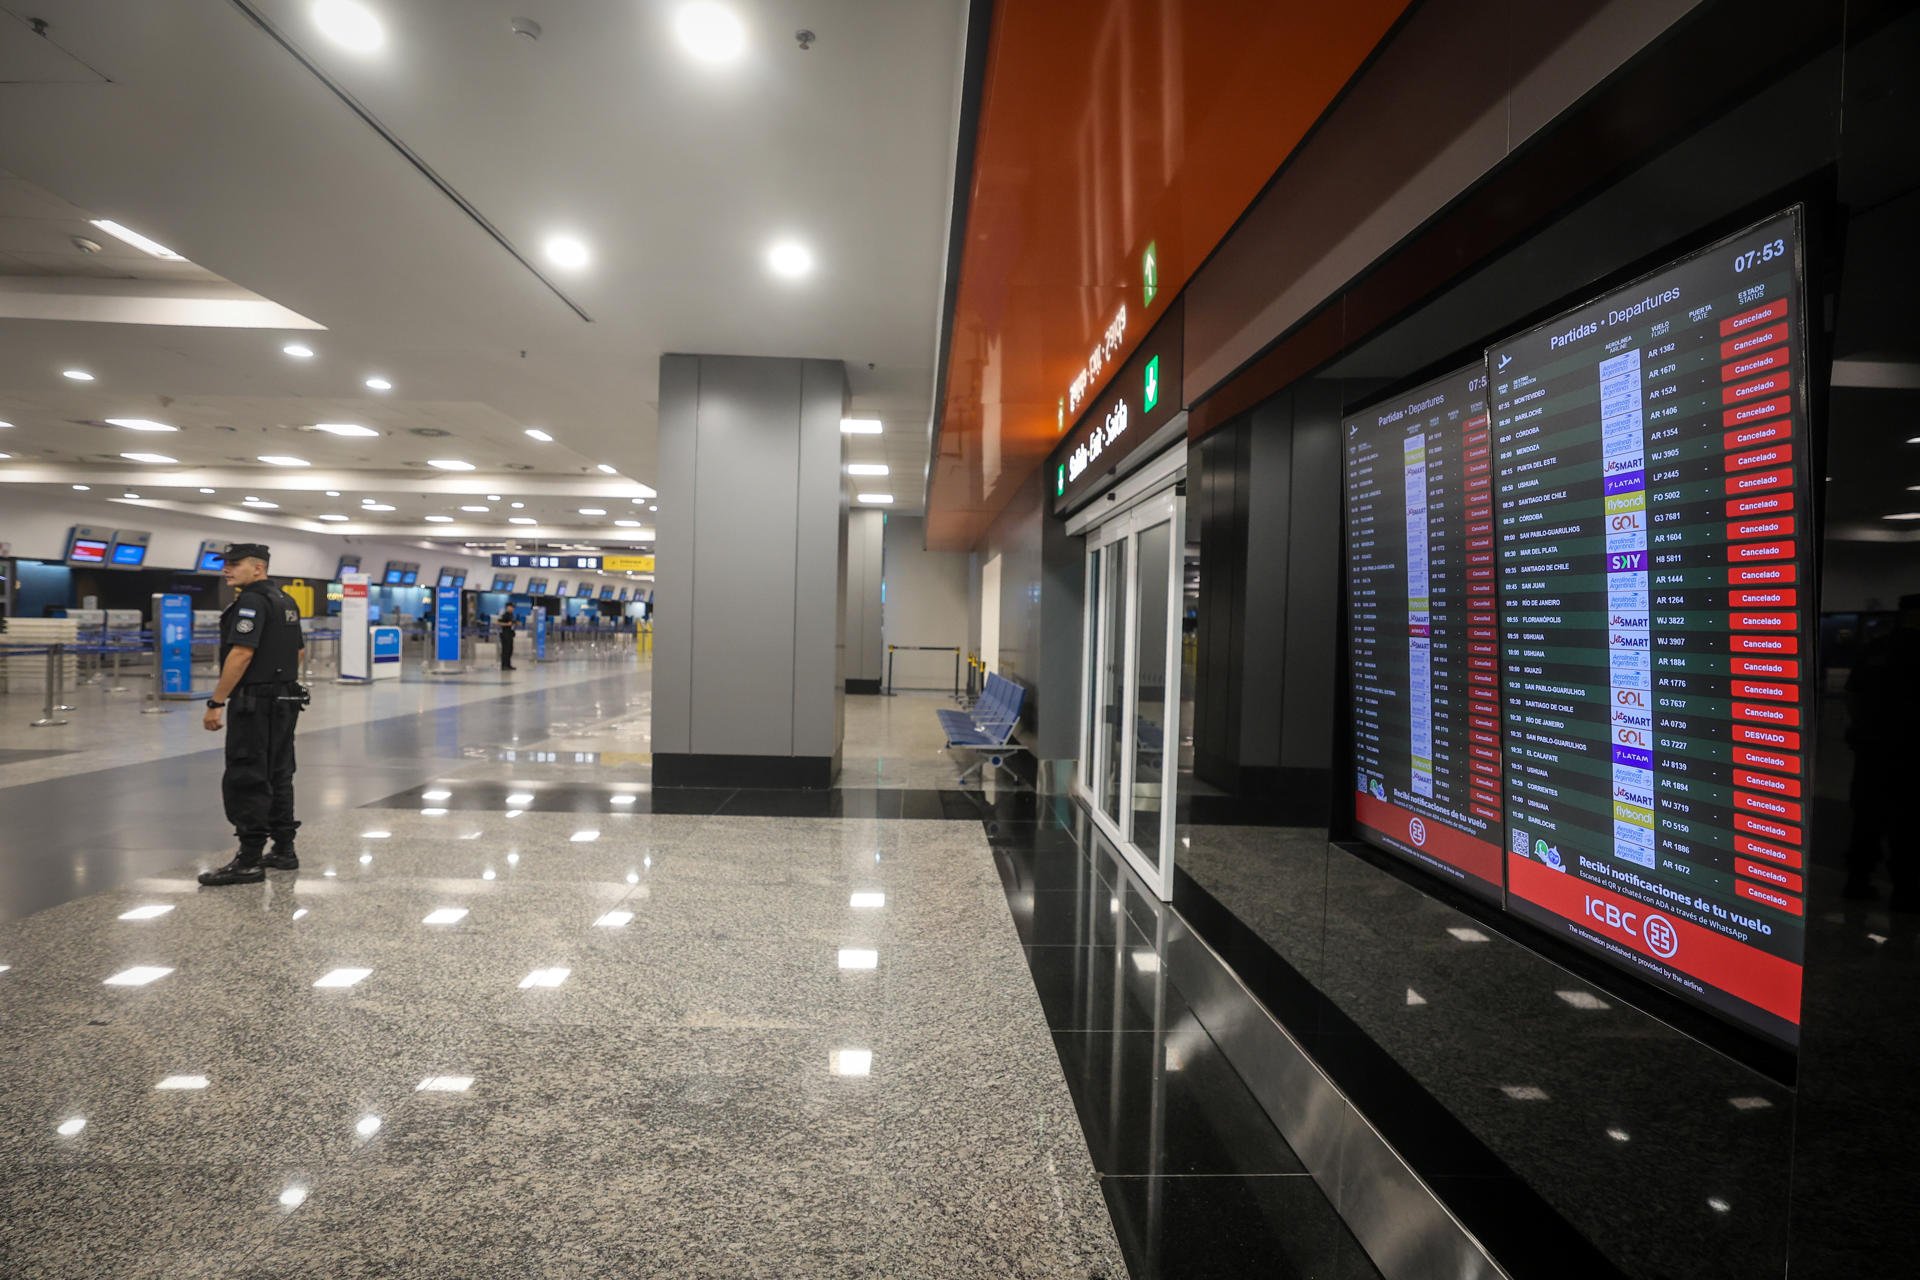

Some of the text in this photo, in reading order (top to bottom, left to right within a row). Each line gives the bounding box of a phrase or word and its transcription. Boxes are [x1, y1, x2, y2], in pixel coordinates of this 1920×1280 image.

[1734, 239, 1783, 272] 07:53
[1737, 282, 1764, 299] ESTADO
[1738, 289, 1763, 305] STATUS
[1688, 302, 1712, 317] PUERTA
[1692, 310, 1708, 322] GATE
[1551, 287, 1679, 349] Partidas Departures
[1733, 309, 1771, 327] Cancelado
[1734, 333, 1772, 350] Cancelado
[1647, 342, 1674, 358] AR 1382
[1648, 363, 1675, 378] AR 1670
[1735, 357, 1773, 373] Cancelado
[1649, 385, 1676, 399] AR 1524
[1735, 381, 1774, 396] Cancelado
[1514, 389, 1545, 404] MONTEVIDEO
[1378, 394, 1445, 428] Partidas Departures
[1514, 407, 1542, 421] BARILOCHE
[1650, 406, 1677, 419] AR 1406
[1736, 405, 1775, 418] Cancelado
[1515, 426, 1539, 438] CÓRDOBA
[1651, 427, 1677, 440] AR 1354
[1737, 428, 1775, 441] Cancelado
[1516, 443, 1539, 454] MENDOZA
[1651, 448, 1678, 460] WJ 3905
[1517, 457, 1556, 471] PUNTA DEL ESTE
[1738, 452, 1776, 464] Cancelado
[1604, 457, 1642, 473] JetSMART
[1653, 469, 1679, 481] LP 2445
[1738, 475, 1777, 487] Cancelado
[1517, 479, 1538, 488] USHUAIA
[1613, 477, 1640, 487] LATAM
[1518, 495, 1543, 505] SANTIAGO
[1551, 491, 1566, 499] CHILE
[1653, 490, 1679, 501] FO 5002
[1739, 500, 1777, 510] Cancelado
[1612, 514, 1638, 530] GOL
[1665, 512, 1680, 520] 7681
[1530, 525, 1580, 537] PABLO-GUARULHOS
[1740, 523, 1778, 533] Cancelado
[1654, 534, 1664, 542] AR
[1740, 547, 1779, 555] Cancelado
[1666, 554, 1680, 562] 5811
[1655, 575, 1665, 583] AR
[1741, 570, 1779, 578] Cancelado
[1609, 615, 1647, 626] JetSMART
[1609, 634, 1648, 646] JetSMART
[1669, 637, 1684, 645] 3907
[1743, 640, 1781, 648] Cancelado
[1743, 663, 1782, 671] Cancelado
[1670, 679, 1685, 687] 1776
[1744, 685, 1782, 695] Cancelado
[1617, 690, 1644, 706] GOL
[1670, 699, 1685, 707] 7637
[1611, 711, 1650, 726] JetSMART
[1744, 708, 1783, 718] Cancelado
[1670, 720, 1686, 728] 0730
[1618, 728, 1645, 746] GOL
[1744, 730, 1784, 742] DESVIADO
[1671, 740, 1686, 749] 7227
[1622, 752, 1648, 762] LATAM
[1745, 753, 1784, 765] Cancelado
[1670, 761, 1686, 770] 8139
[1661, 779, 1688, 791] AR 1894
[1746, 776, 1784, 789] Cancelado
[1613, 786, 1652, 805] JetSMART
[1394, 788, 1410, 801] Recibí
[1410, 795, 1451, 818] notificaciones
[1451, 809, 1458, 819] de
[1459, 813, 1467, 822] tu
[1467, 816, 1488, 830] vuelo
[1661, 799, 1688, 812] WJ 3719
[1746, 798, 1785, 812] Cancelado
[1662, 819, 1688, 832] FO 5150
[1747, 820, 1785, 835] Cancelado
[1662, 839, 1689, 853] AR 1886
[1747, 843, 1785, 859] Cancelado
[1662, 859, 1689, 874] AR 1672
[1748, 865, 1786, 882] Cancelado
[1579, 855, 1770, 934] Recibí notificaciones de tu vuelo
[1748, 887, 1786, 905] Cancelado
[1585, 895, 1636, 935] ICBC
[1607, 880, 1616, 889] QR
[1642, 895, 1654, 903] con
[1655, 897, 1669, 909] ADA
[1676, 907, 1697, 919] través
[1708, 919, 1747, 940] WhatsApp
[1568, 923, 1577, 933] The
[1578, 929, 1605, 946] information
[1606, 943, 1630, 958] published
[1637, 958, 1662, 973] provided
[1663, 968, 1671, 978] by
[1672, 973, 1682, 983] the
